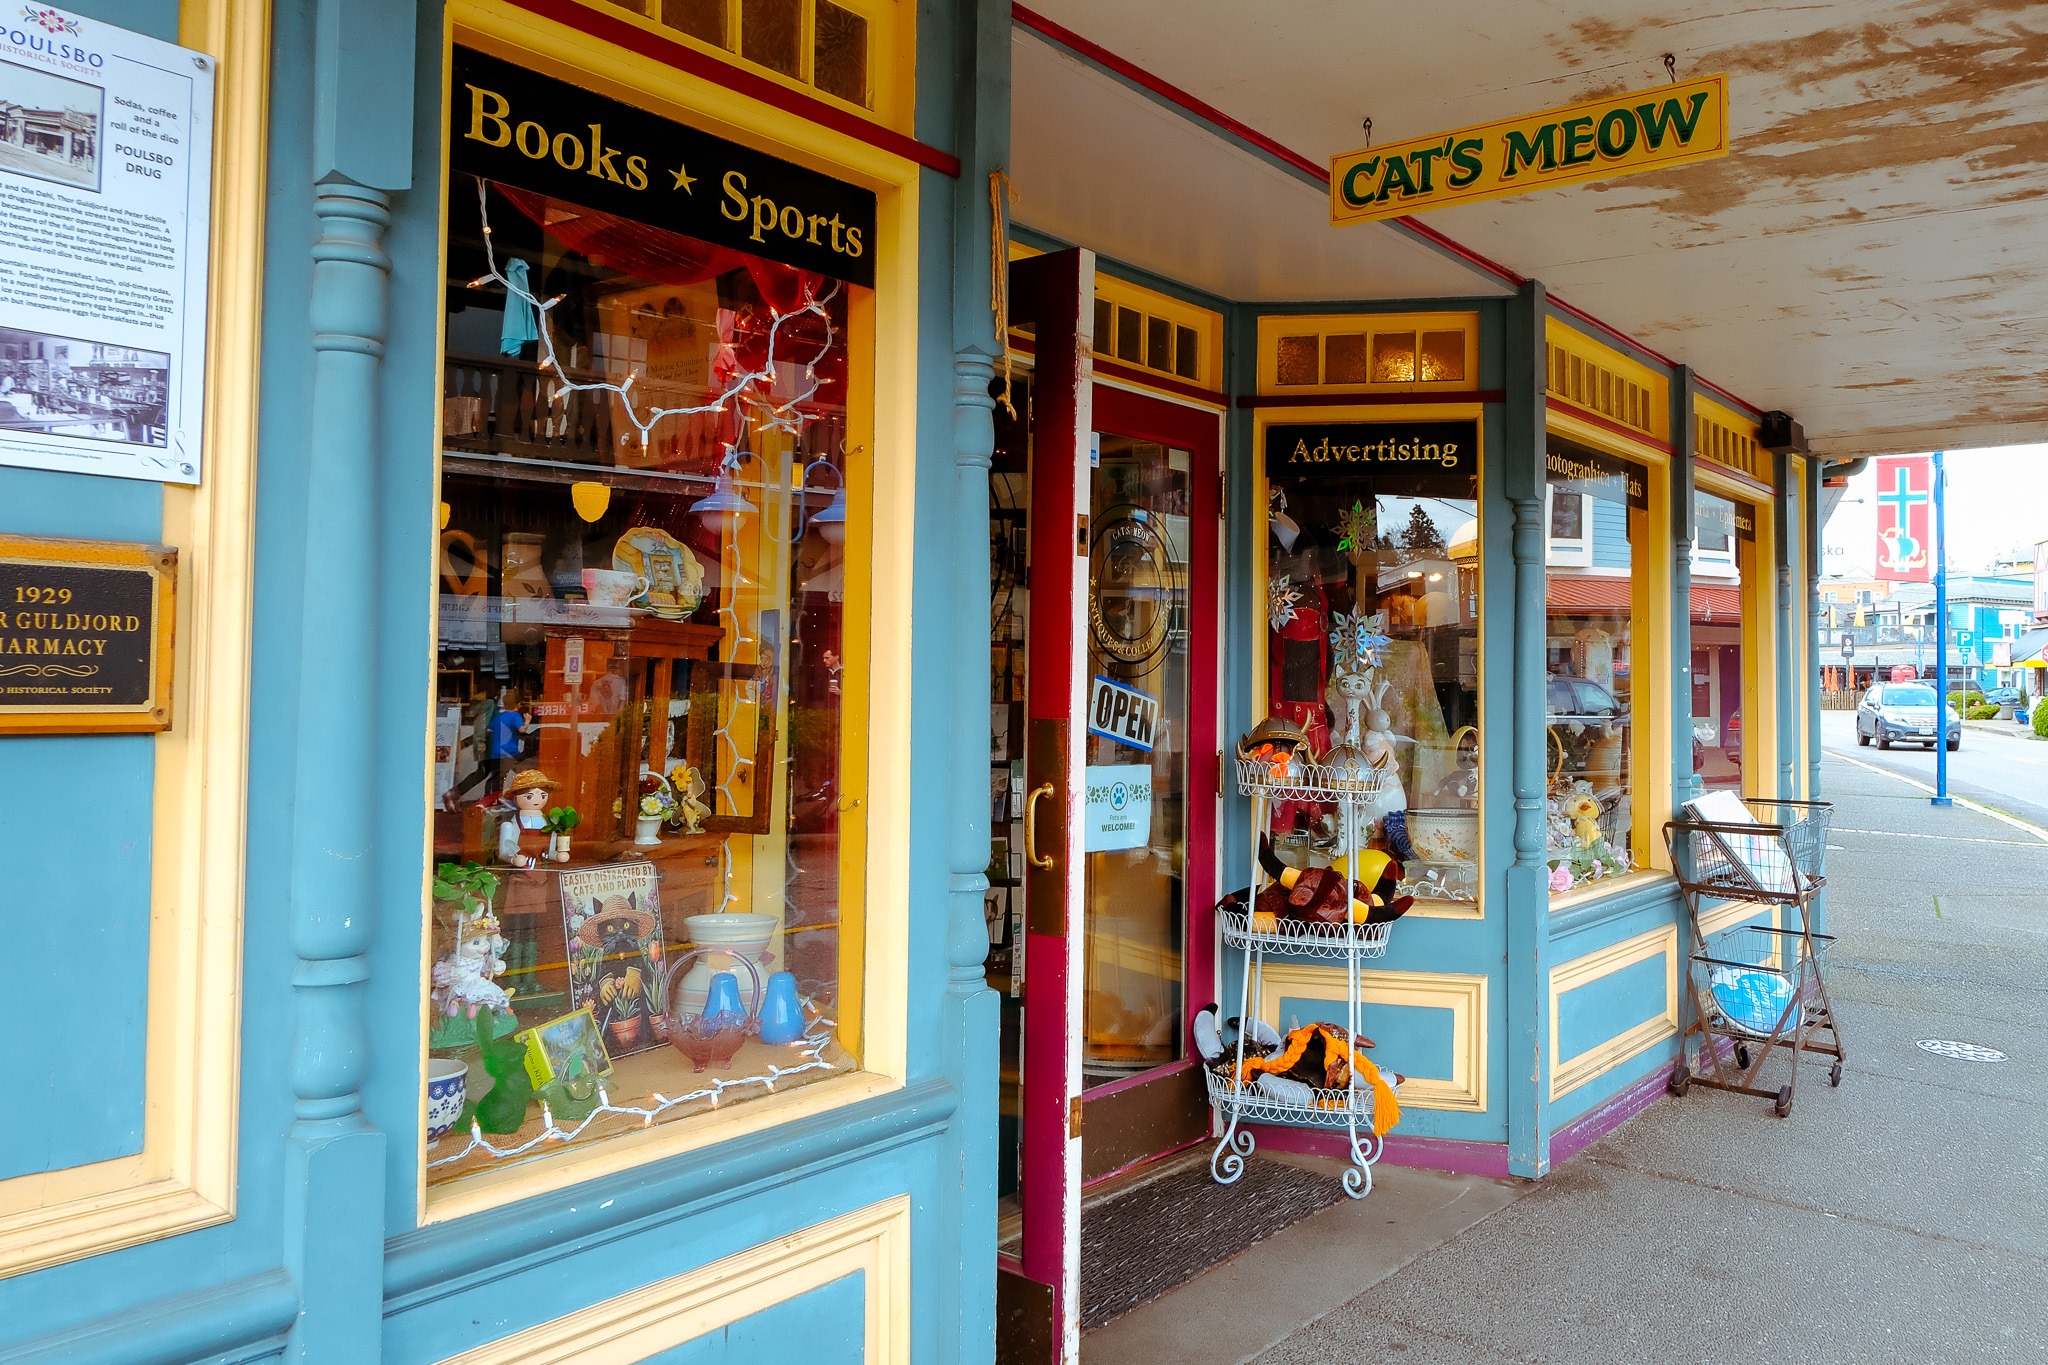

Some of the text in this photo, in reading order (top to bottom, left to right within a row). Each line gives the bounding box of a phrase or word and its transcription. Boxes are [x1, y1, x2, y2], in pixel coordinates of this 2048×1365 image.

[0, 25, 104, 68] POULSBO
[60, 60, 103, 78] SOCIETY
[114, 96, 178, 120] Sodas, coffee
[134, 115, 152, 125] and
[110, 121, 179, 144] roll of the dice
[115, 143, 173, 166] POULSBO
[1340, 92, 1709, 209] CAT'S MEOW
[126, 162, 162, 180] DRUG
[464, 83, 863, 258] Books Sports
[1288, 437, 1458, 467] Advertising
[1620, 471, 1642, 497] Hats
[15, 586, 72, 604] 1929
[15, 611, 140, 632] GULDJORD
[1961, 633, 1971, 645] P
[7, 686, 68, 694] HISTORICAL
[71, 686, 113, 694] SOCIETY
[1095, 684, 1155, 744] OPEN
[1101, 822, 1135, 832] WELCOME!
[563, 865, 652, 887] EASILY DISTRACTED BY
[573, 878, 647, 897] CATS AND PLANTS
